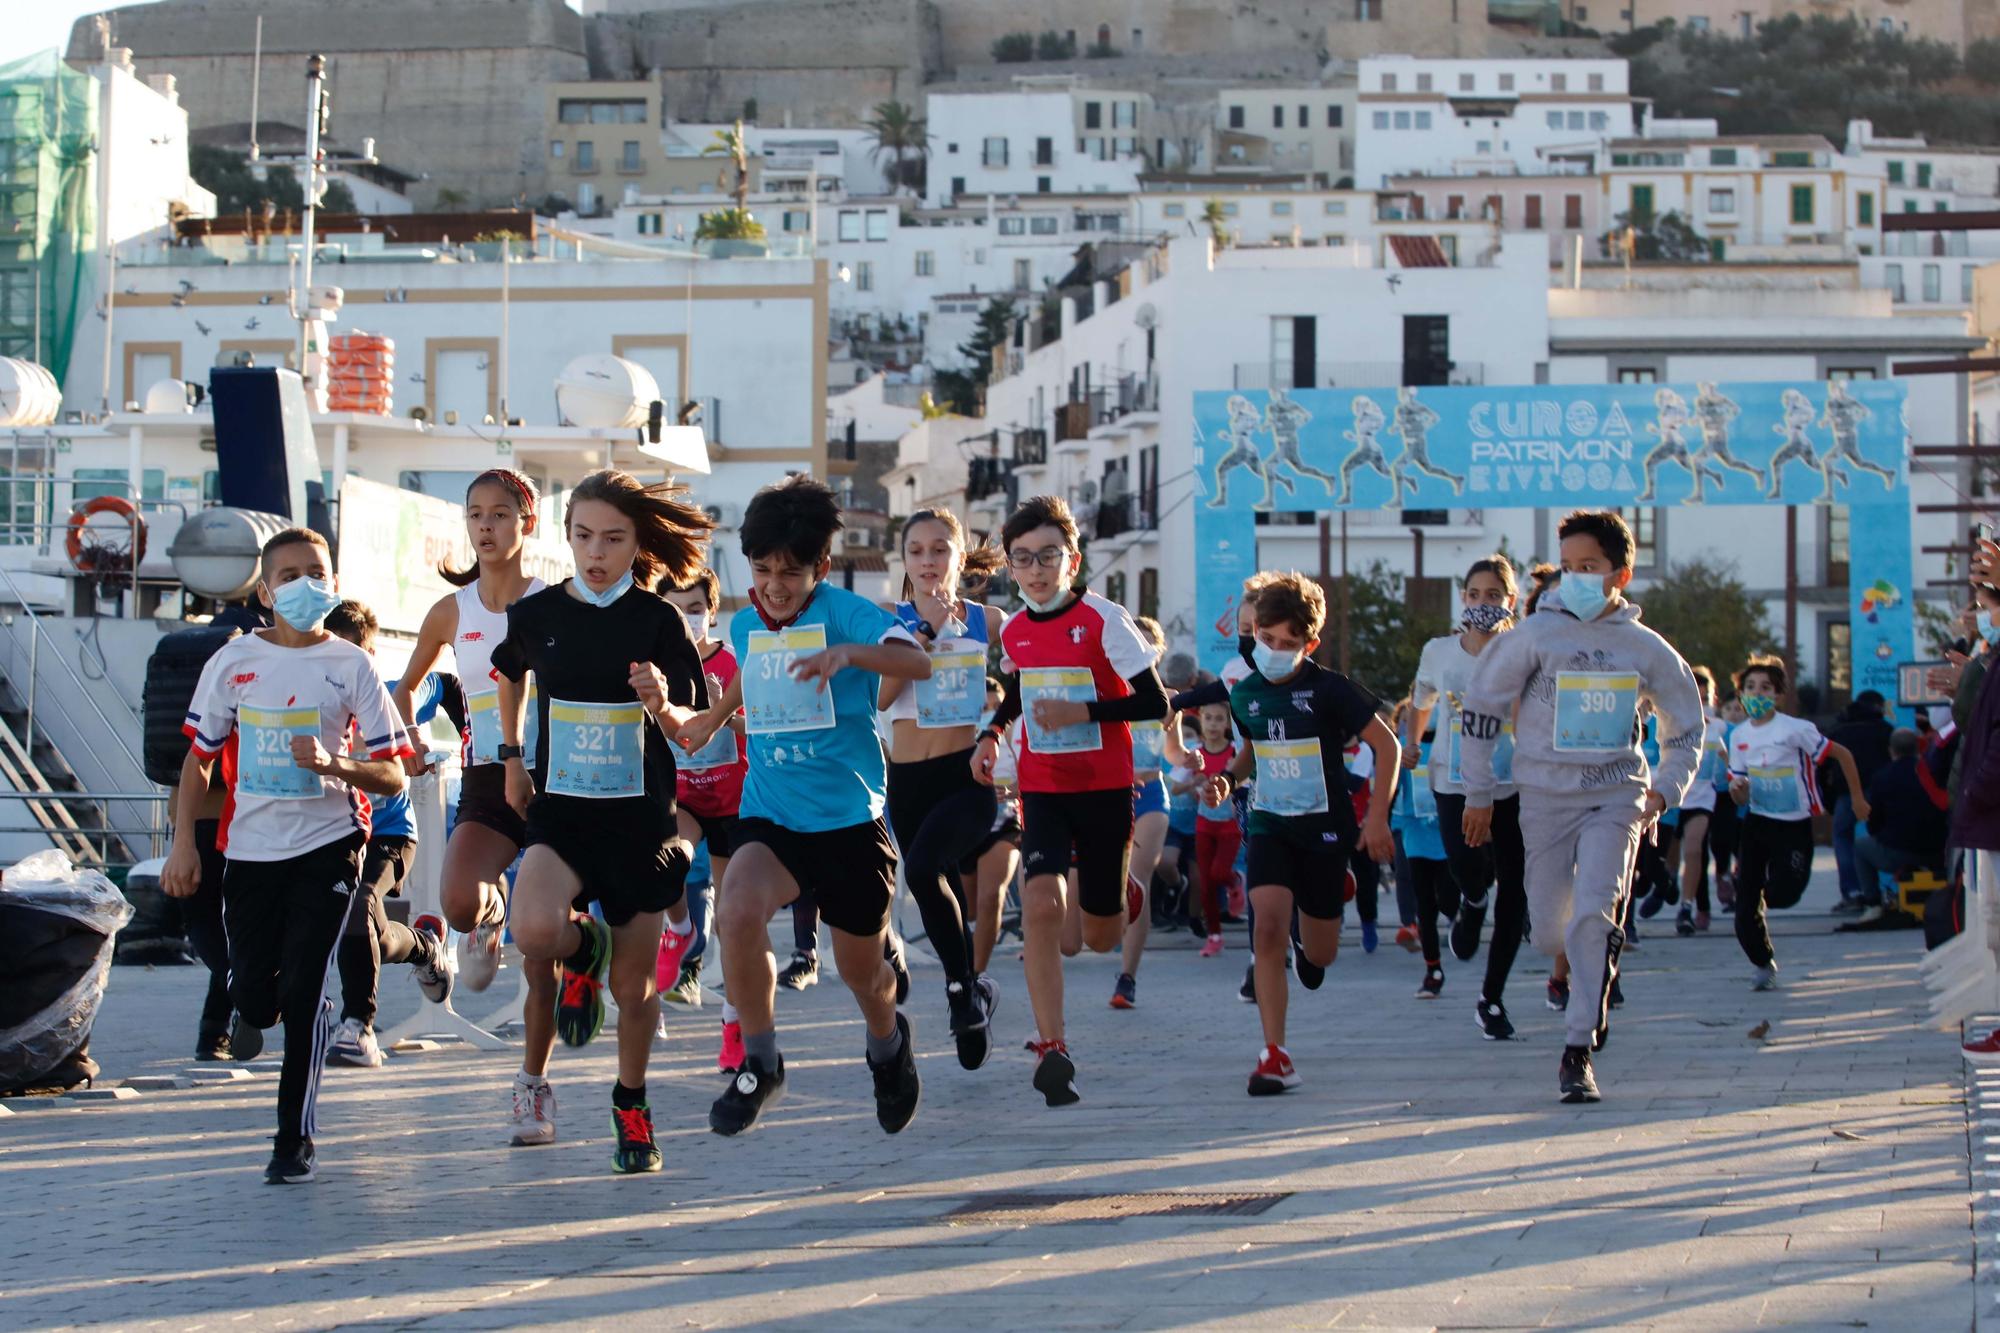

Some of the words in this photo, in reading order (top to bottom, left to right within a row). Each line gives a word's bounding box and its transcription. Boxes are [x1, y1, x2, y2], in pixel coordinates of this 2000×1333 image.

[1471, 439, 1633, 476] PATRIMONI
[936, 669, 968, 690] 316
[1580, 691, 1617, 713] 390
[255, 728, 292, 753] 320
[575, 725, 617, 751] 321
[1268, 758, 1302, 779] 338
